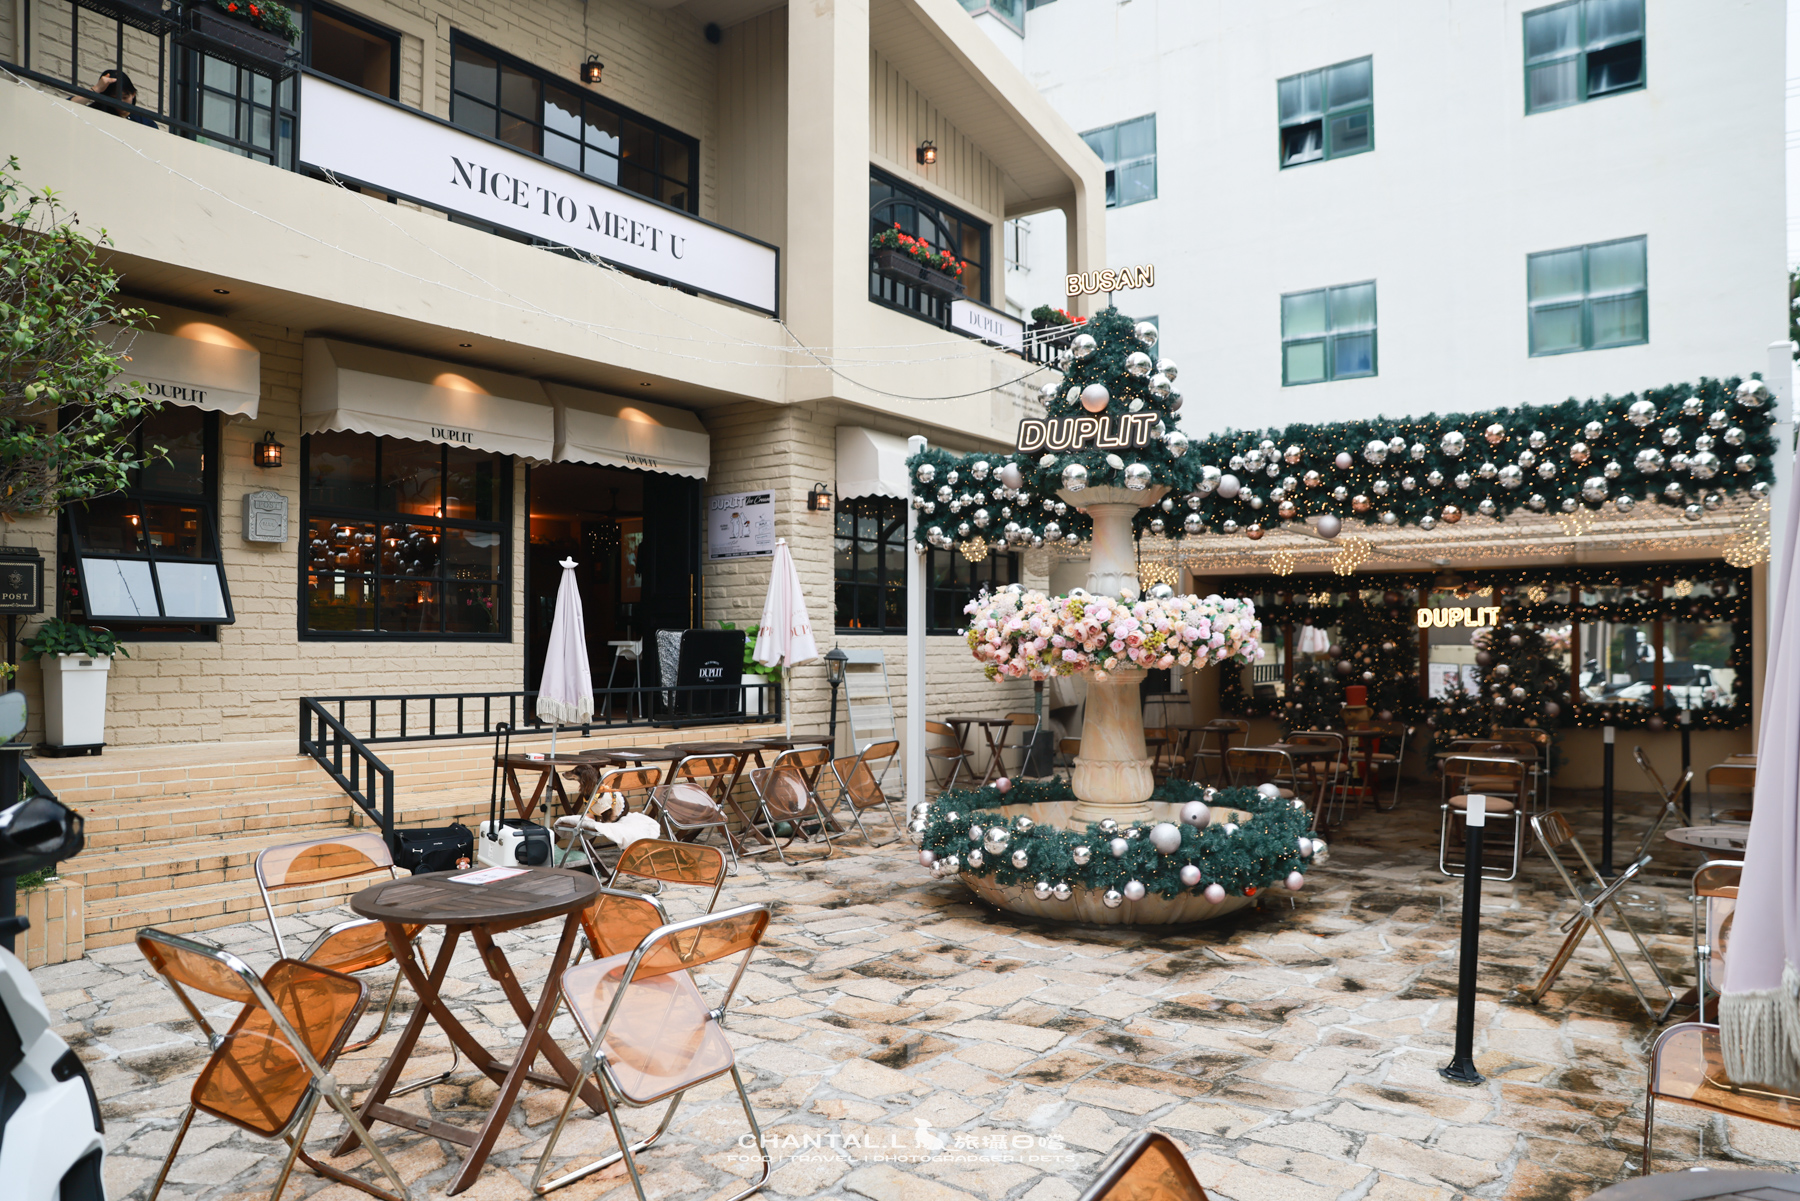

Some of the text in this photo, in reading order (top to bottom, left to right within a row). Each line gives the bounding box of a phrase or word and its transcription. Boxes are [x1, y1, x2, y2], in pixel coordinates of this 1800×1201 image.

[450, 156, 686, 260] NICE TO MEET U
[1065, 264, 1155, 297] BUSAN
[969, 310, 1004, 337] DUPLIT
[147, 382, 207, 404] DUPLIT
[431, 426, 474, 444] DUPLIT
[1018, 412, 1158, 452] DUPLIT
[711, 496, 745, 511] DUPLIT
[1417, 606, 1501, 628] DUPLIT
